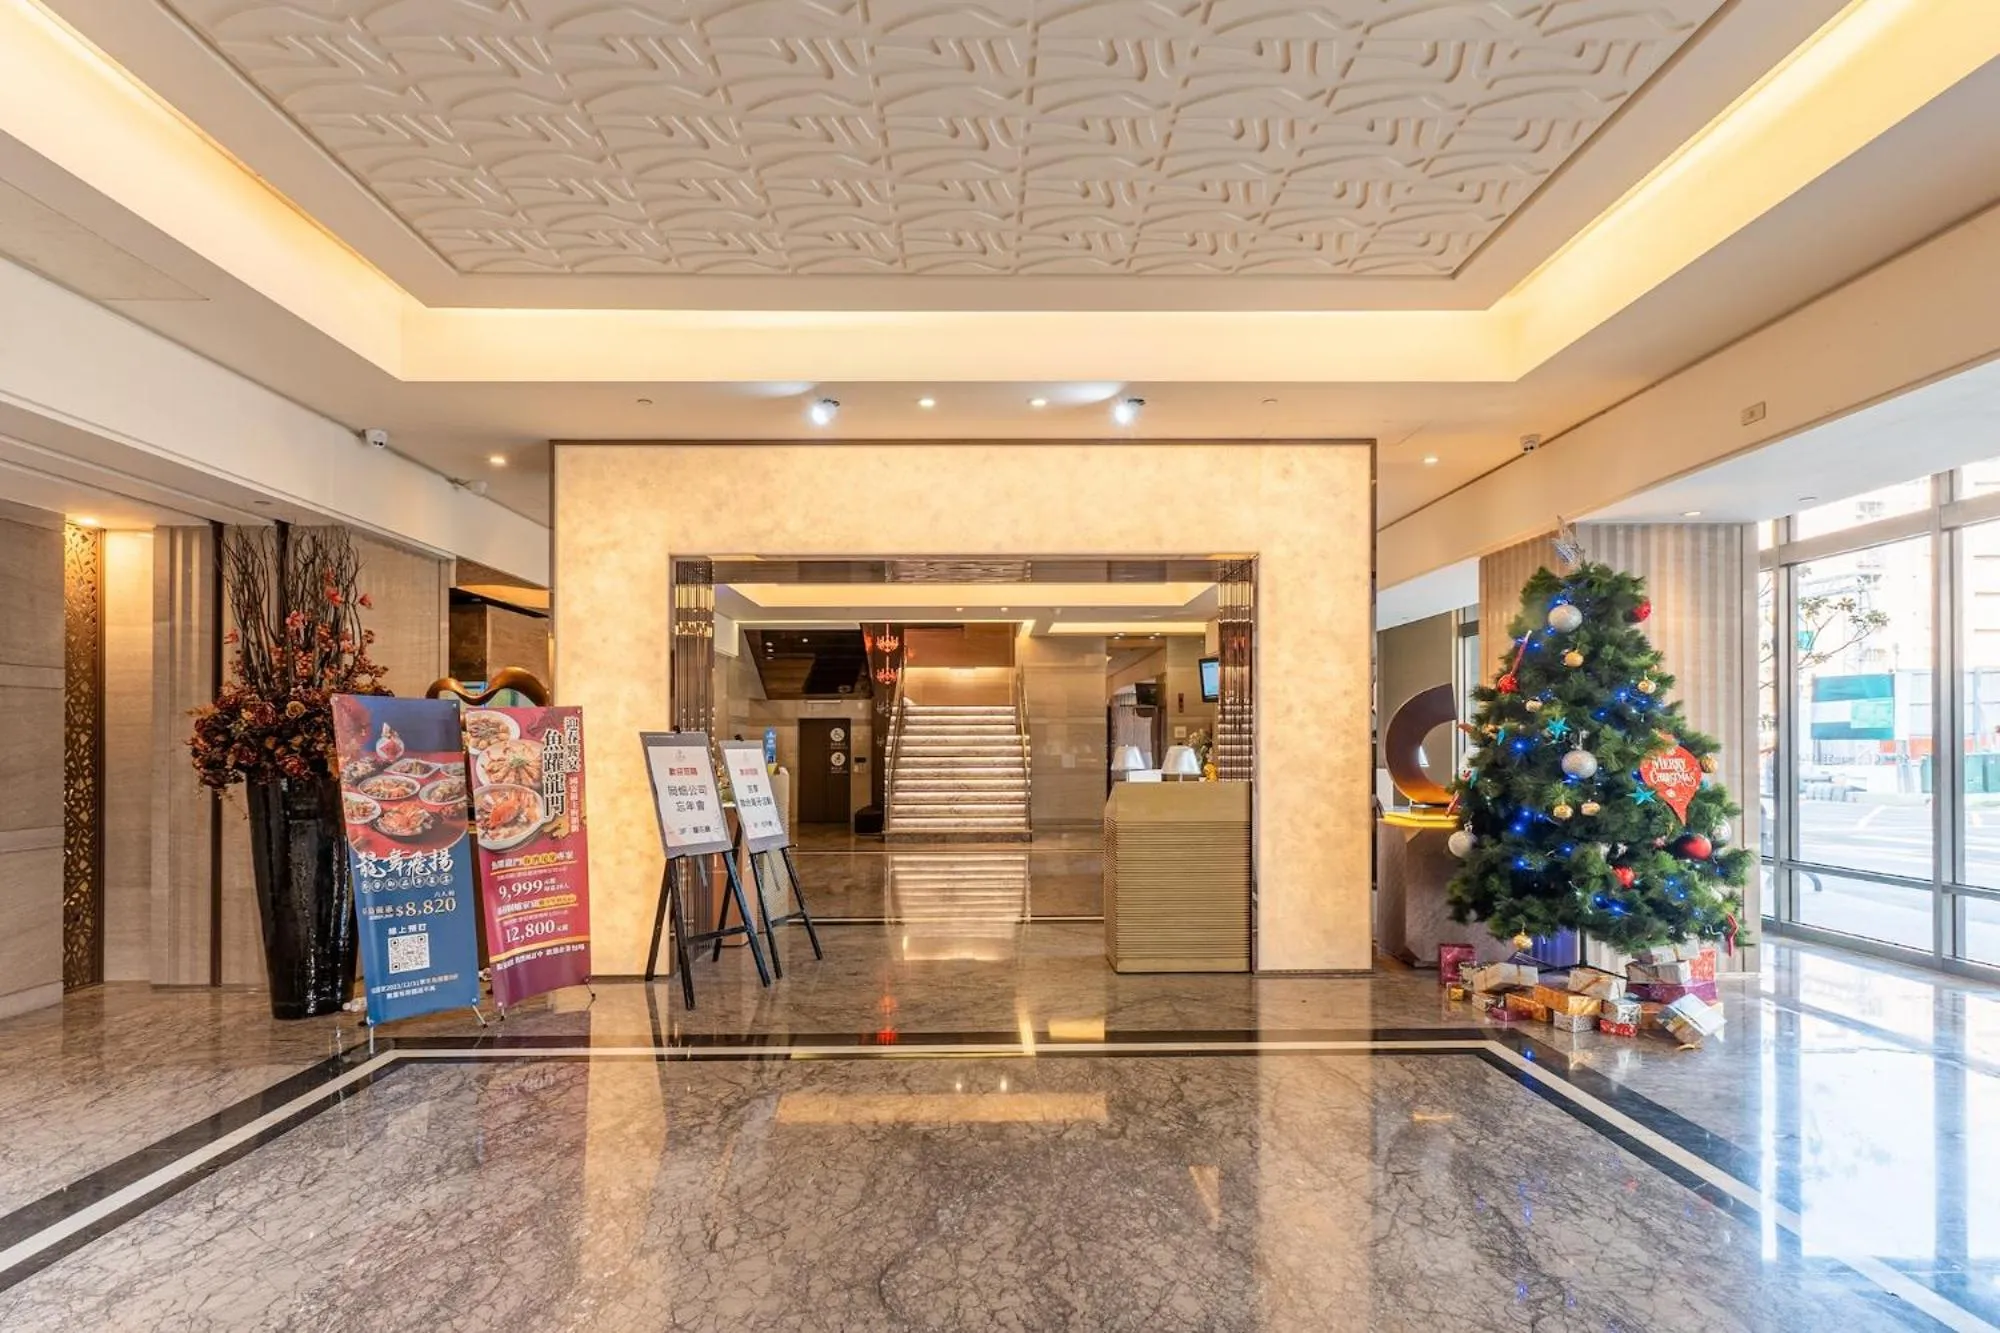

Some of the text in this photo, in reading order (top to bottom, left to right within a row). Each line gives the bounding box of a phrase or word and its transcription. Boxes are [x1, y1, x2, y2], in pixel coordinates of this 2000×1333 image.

[543, 729, 565, 817] 魚躍龍門
[499, 879, 543, 902] 9,999
[396, 897, 456, 917] $8,820
[506, 919, 555, 943] 12,800
